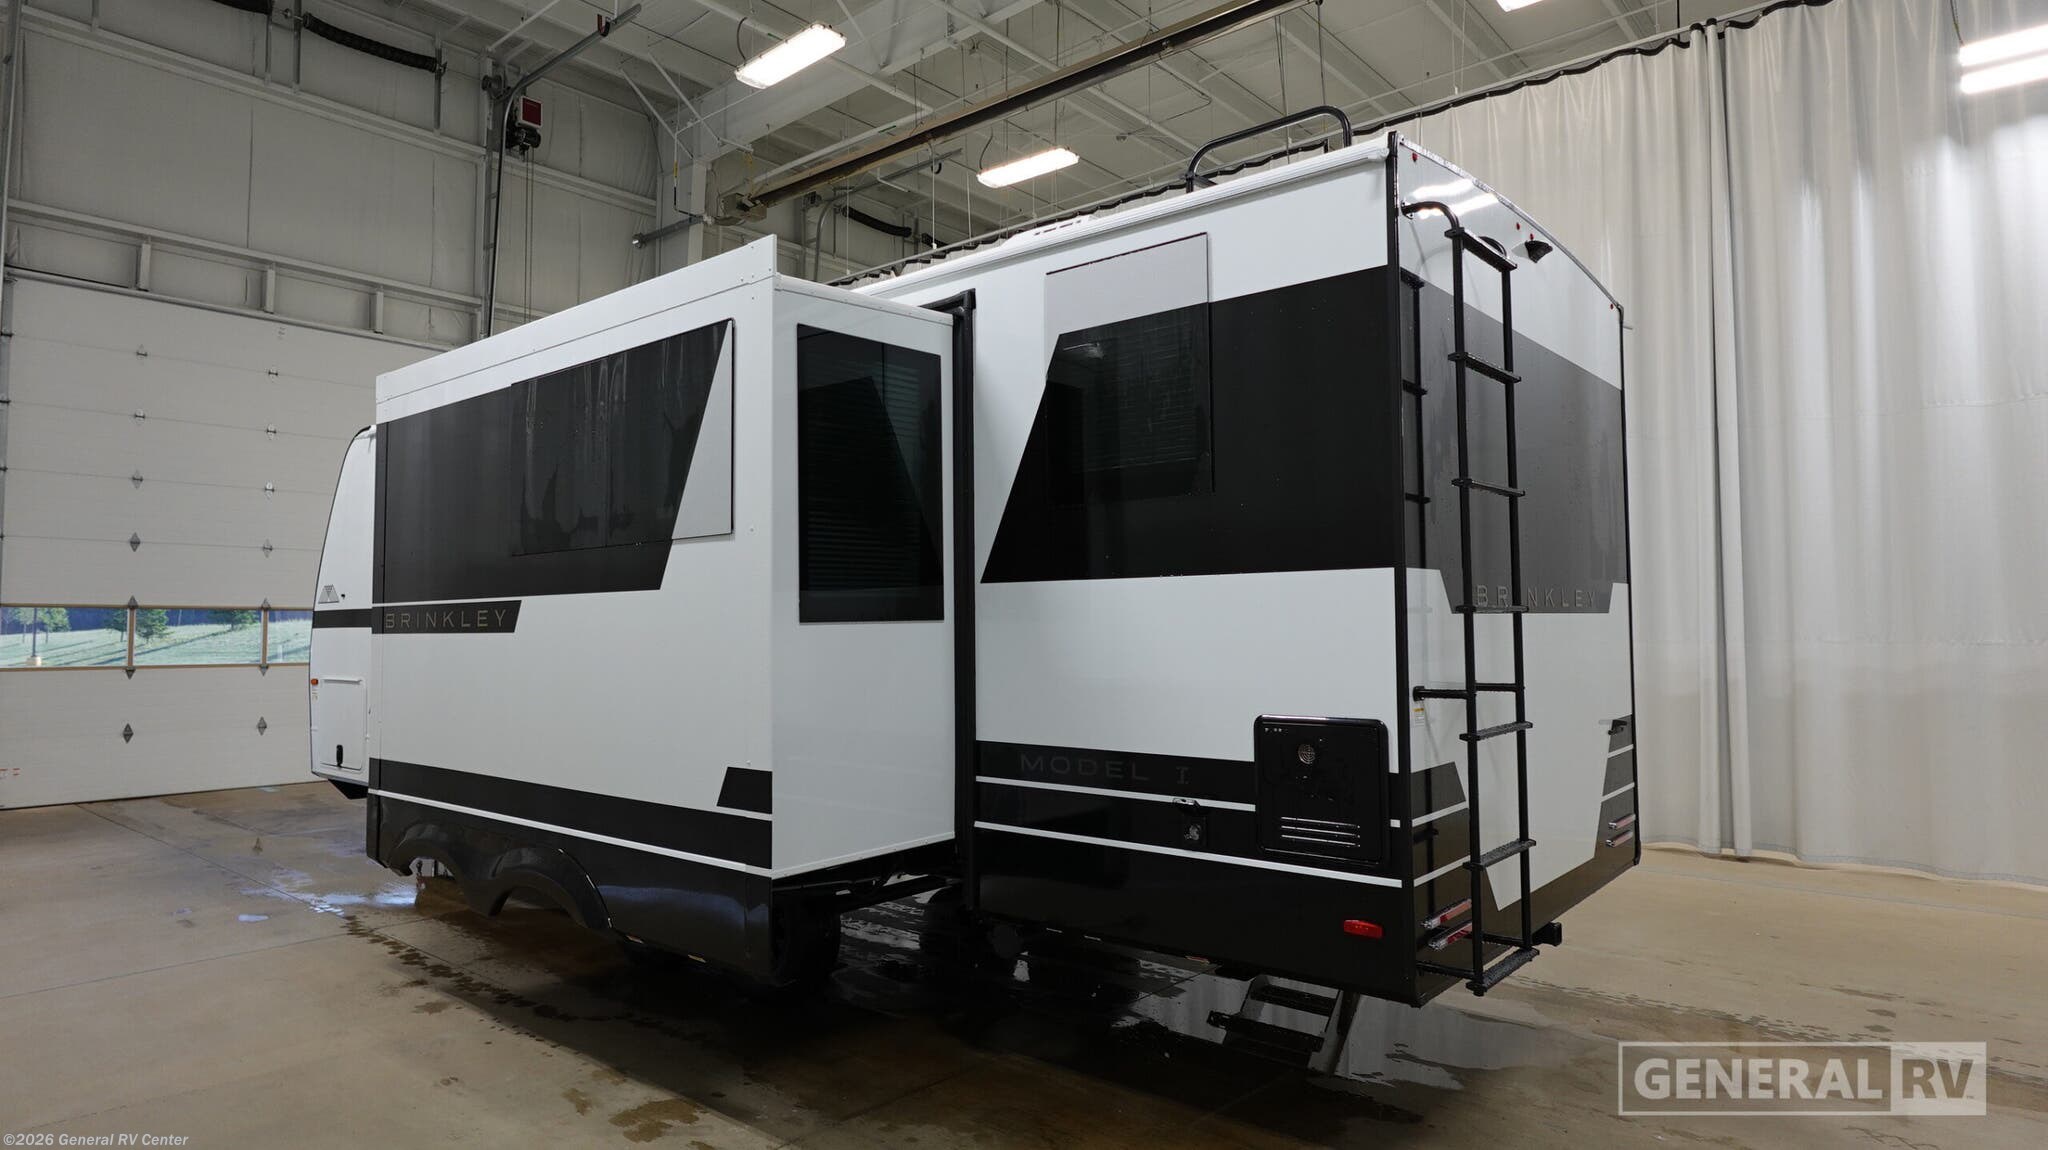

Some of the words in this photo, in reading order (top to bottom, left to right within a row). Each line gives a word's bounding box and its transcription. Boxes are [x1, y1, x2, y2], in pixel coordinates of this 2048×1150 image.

[1475, 584, 1597, 608] BRNKLEY
[385, 609, 507, 629] BRINKLEY
[1019, 753, 1150, 782] MODEL
